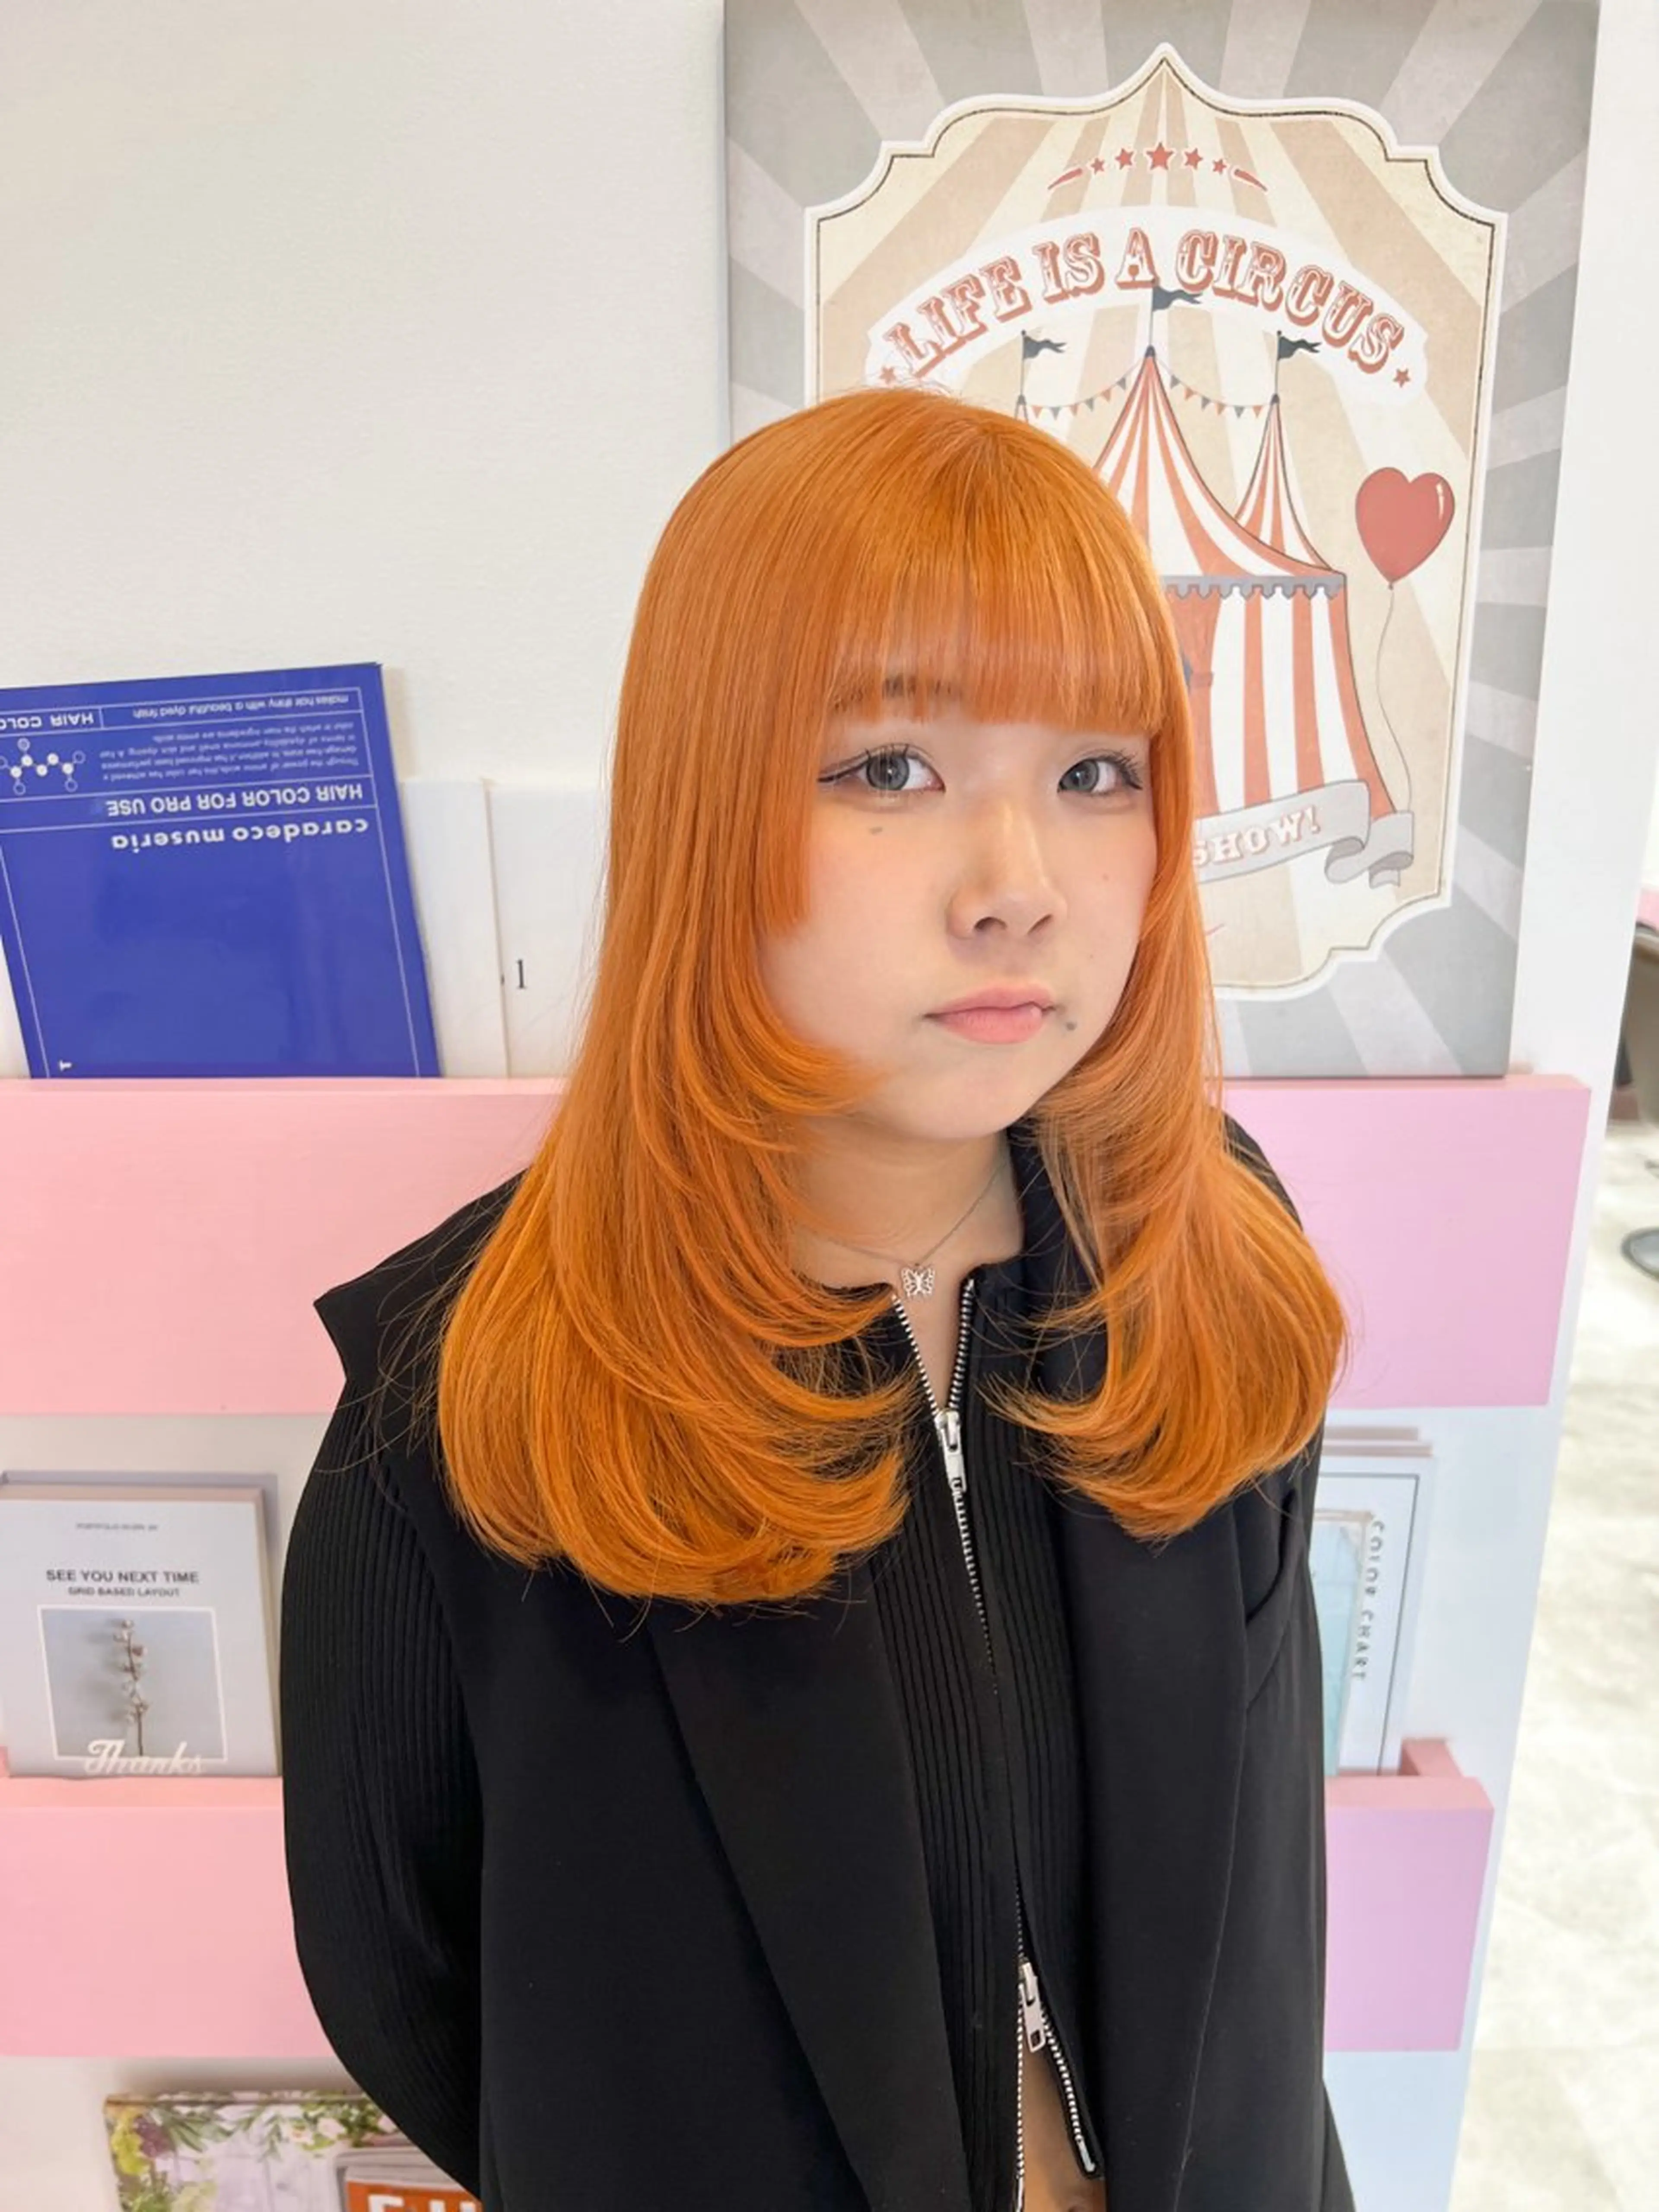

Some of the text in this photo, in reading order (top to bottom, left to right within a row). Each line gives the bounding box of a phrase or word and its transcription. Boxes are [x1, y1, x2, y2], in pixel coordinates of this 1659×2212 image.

[883, 227, 1406, 378] LIFE IS A CIRCUS
[50, 712, 94, 728] HAIR
[105, 783, 363, 817] HAIR COLOR FOR PRO USE
[111, 819, 369, 853] caradeco museria
[46, 1569, 199, 1584] SEE YOU NEXT TIME
[1352, 1520, 1386, 1680] COLOR CHART
[84, 1738, 203, 1775] Thanks
